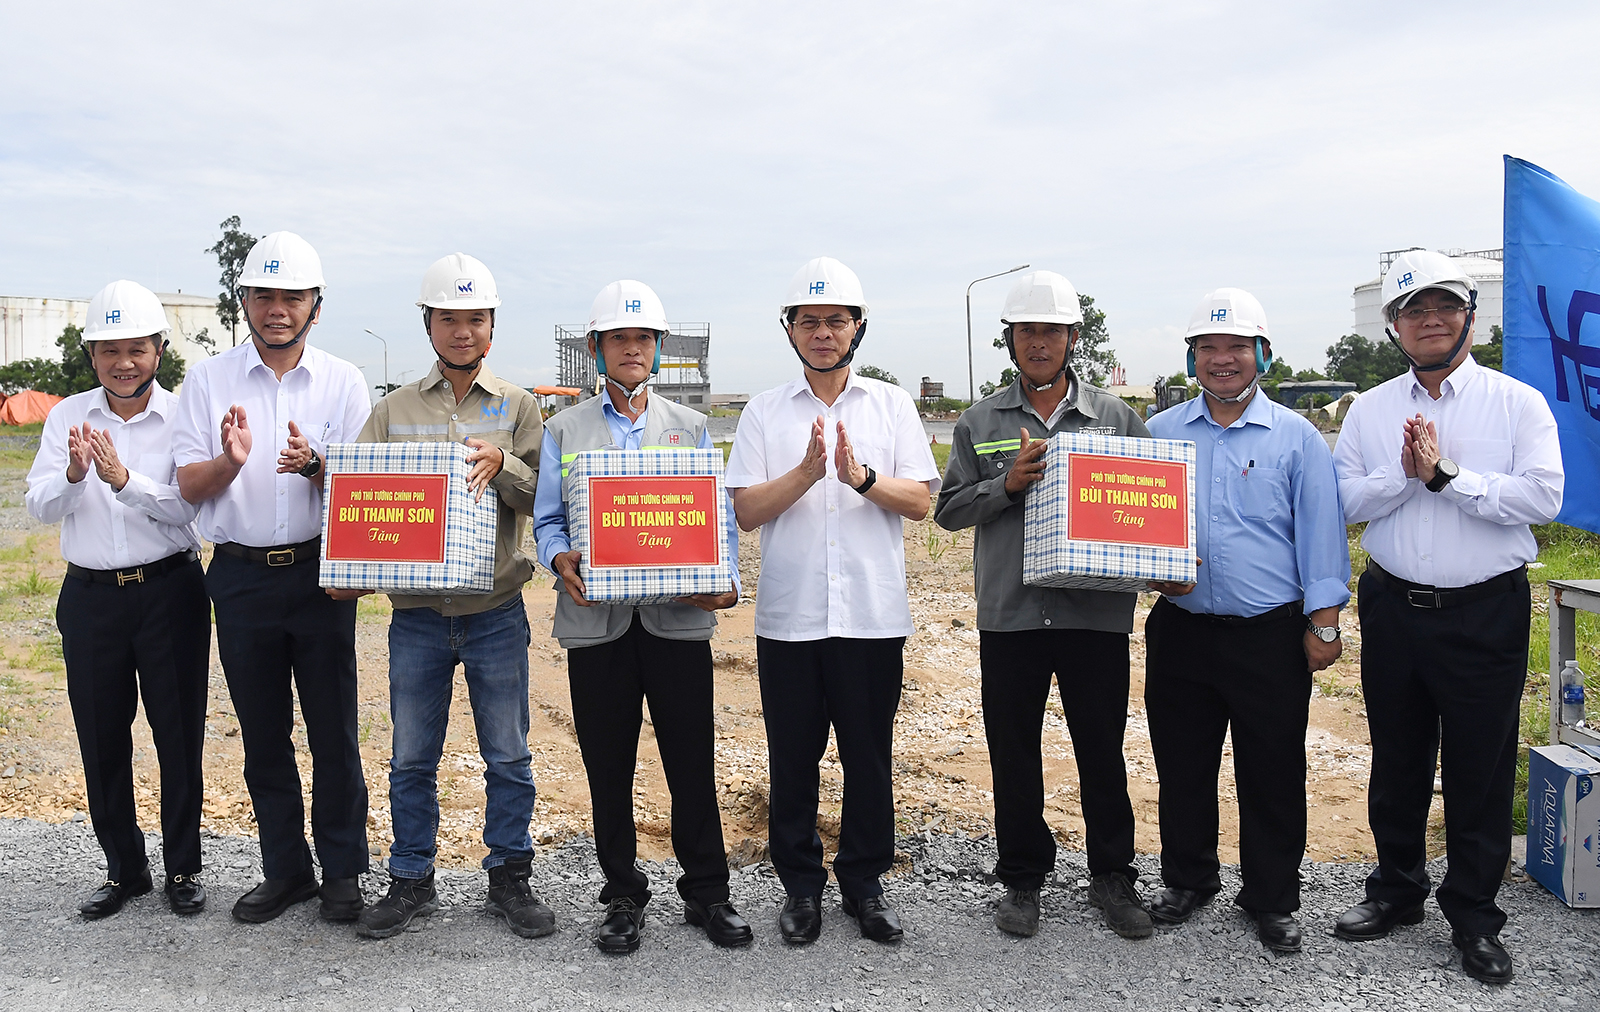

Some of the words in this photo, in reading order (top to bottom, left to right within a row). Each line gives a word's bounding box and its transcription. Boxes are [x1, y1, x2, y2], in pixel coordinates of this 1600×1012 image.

[1091, 471, 1102, 482] PHÓ
[1104, 471, 1115, 483] THỦ
[1136, 475, 1153, 487] CHÍNH
[1154, 476, 1166, 488] PHỦ
[351, 489, 362, 501] PHÓ
[363, 488, 373, 501] THỦ
[394, 490, 412, 501] CHÍNH
[413, 489, 424, 501] PHỦ
[614, 493, 626, 504] PHÓ
[627, 492, 639, 504] THỦ
[661, 493, 680, 504] CHÍNH
[681, 492, 694, 503] PHỦ
[1079, 486, 1102, 503] BÙI
[1105, 489, 1147, 507] THANH
[1151, 493, 1177, 509] SƠN
[339, 504, 359, 522] BÙI
[363, 507, 404, 523] THANH
[407, 507, 434, 523] SƠN
[602, 508, 625, 527] BÙI
[629, 511, 674, 526] THANH
[678, 509, 706, 526] SƠN
[1112, 509, 1145, 528] Tặng
[368, 527, 400, 544] Tặng
[637, 531, 672, 548] Tặng
[1540, 777, 1558, 866] AQUAFINA
